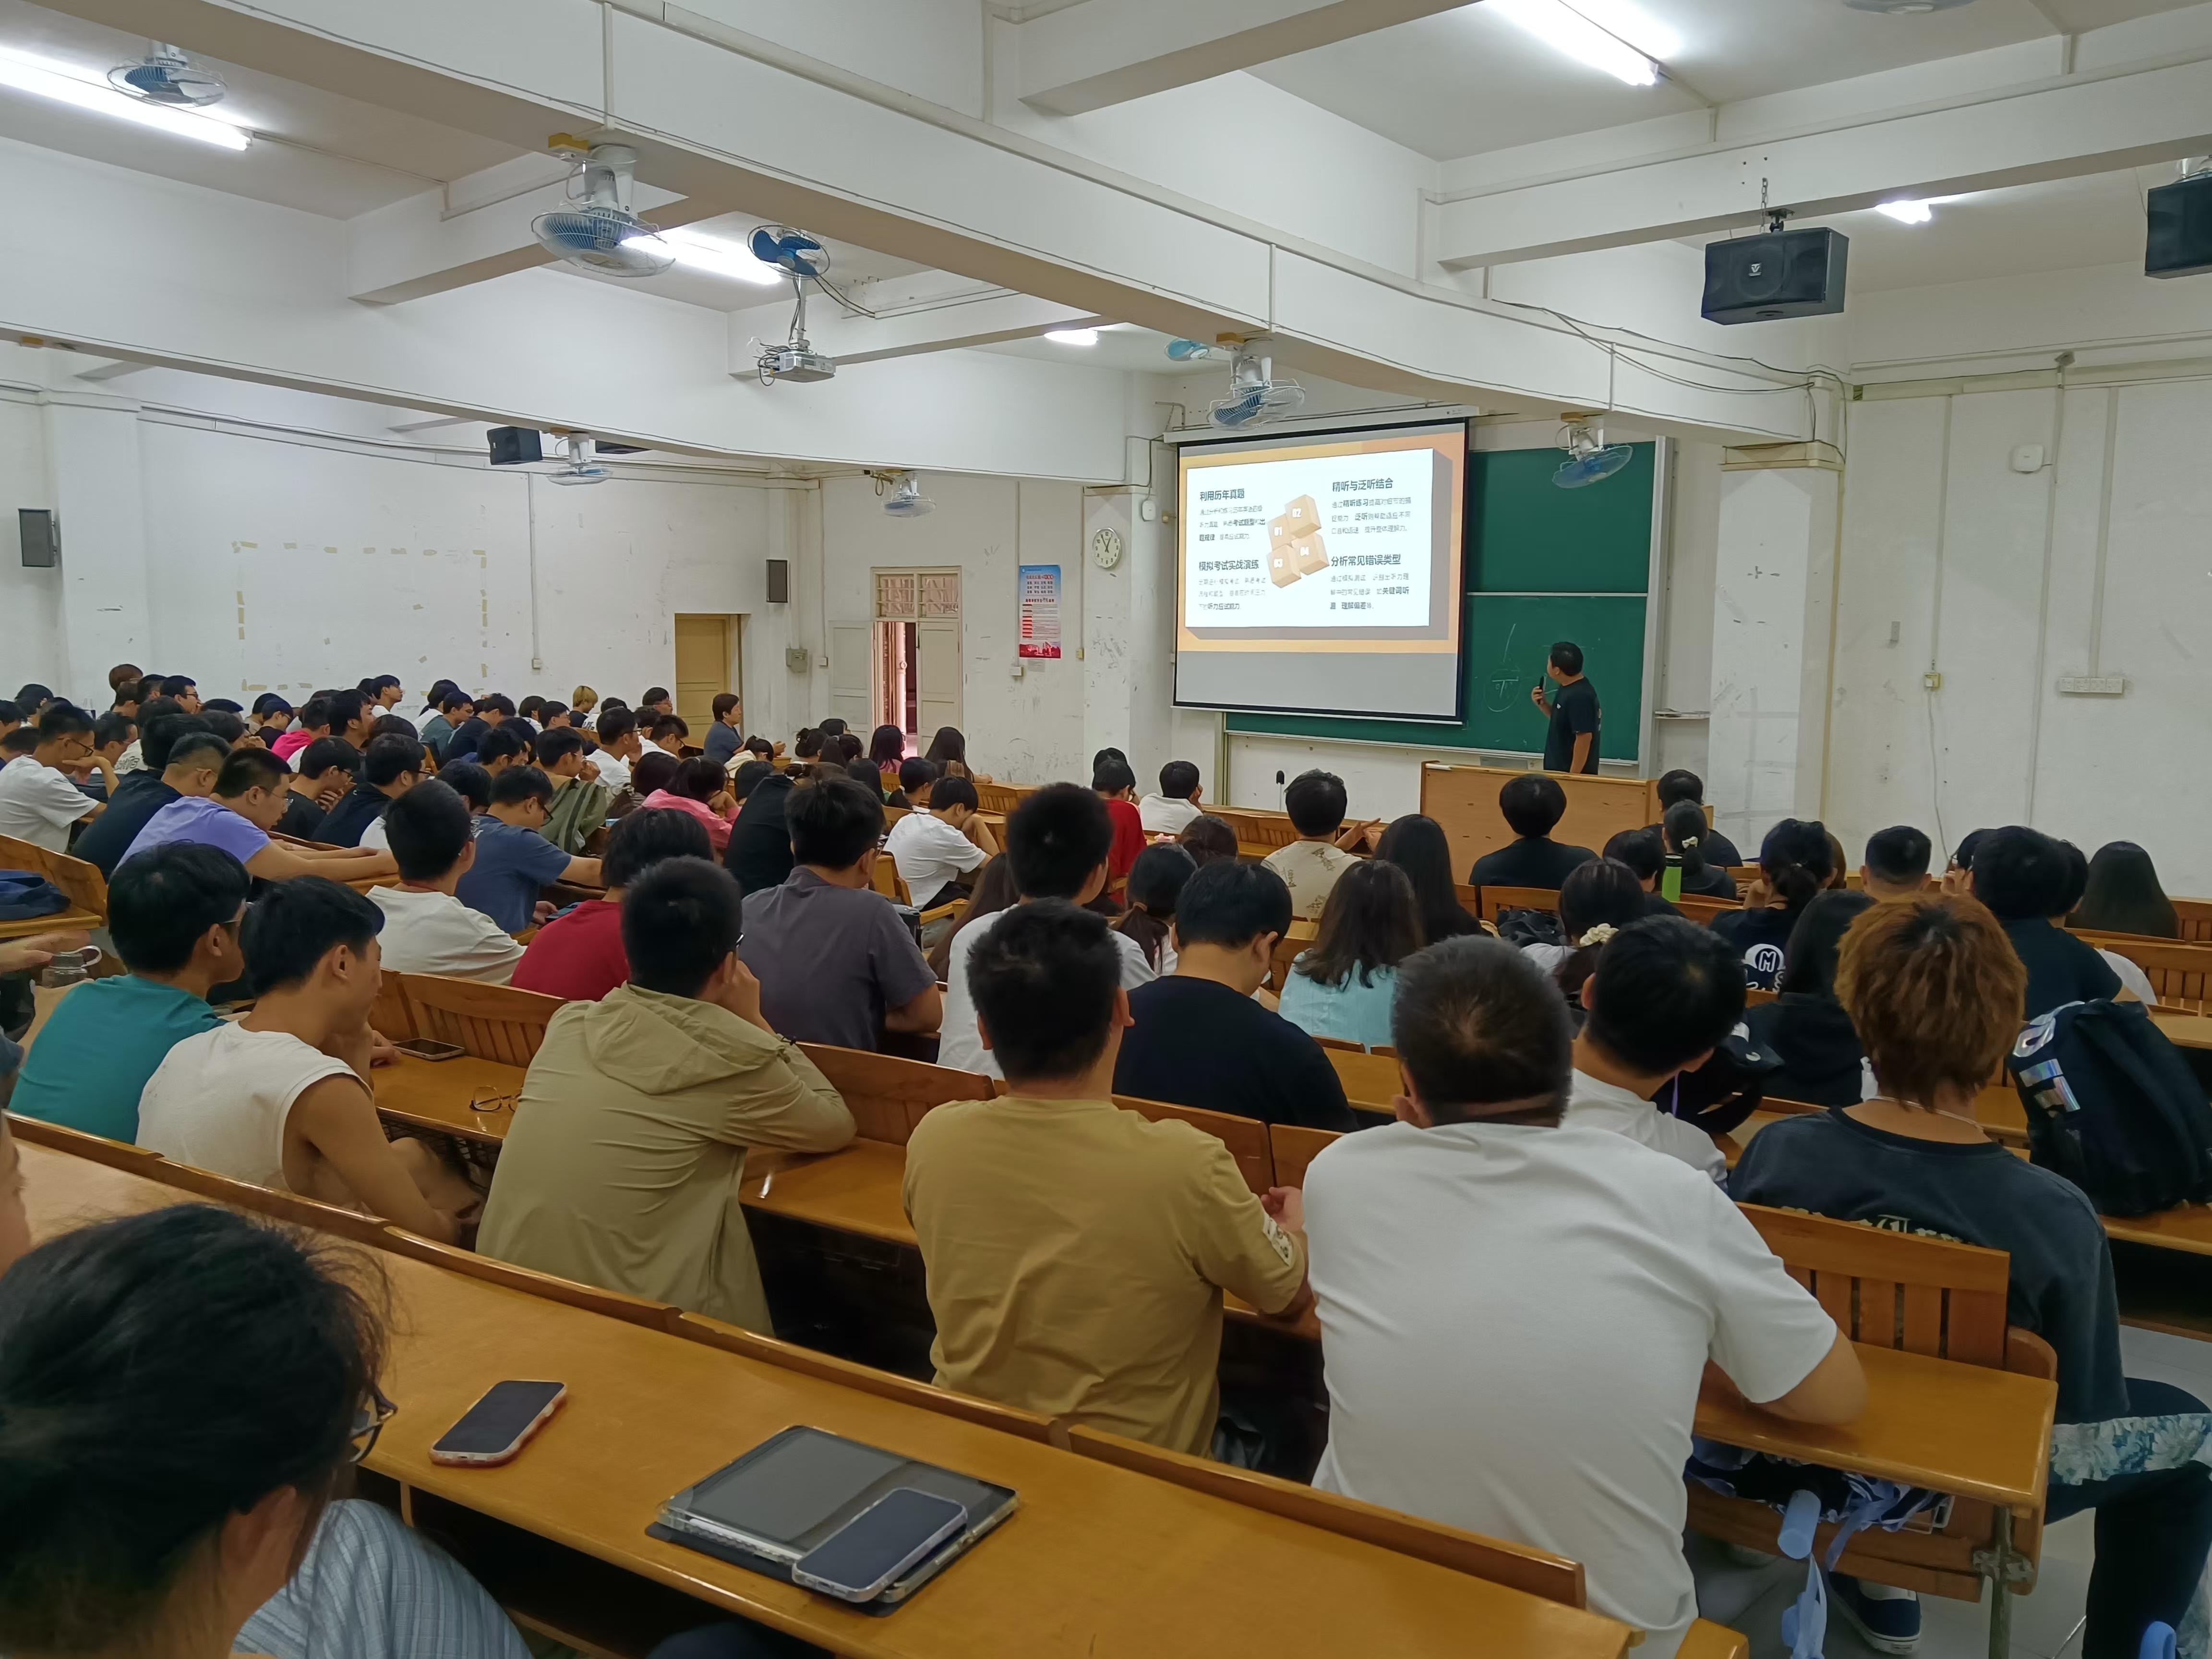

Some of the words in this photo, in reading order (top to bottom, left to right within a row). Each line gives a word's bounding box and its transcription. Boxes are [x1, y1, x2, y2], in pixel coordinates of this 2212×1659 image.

[1332, 478, 1393, 492] 精听与泛听结合
[1200, 488, 1245, 501] 利用历年真题
[1199, 559, 1259, 571] 模拟考试实战演练
[1331, 553, 1401, 567] 分析常见错误类型
[1758, 951, 1777, 973] M
